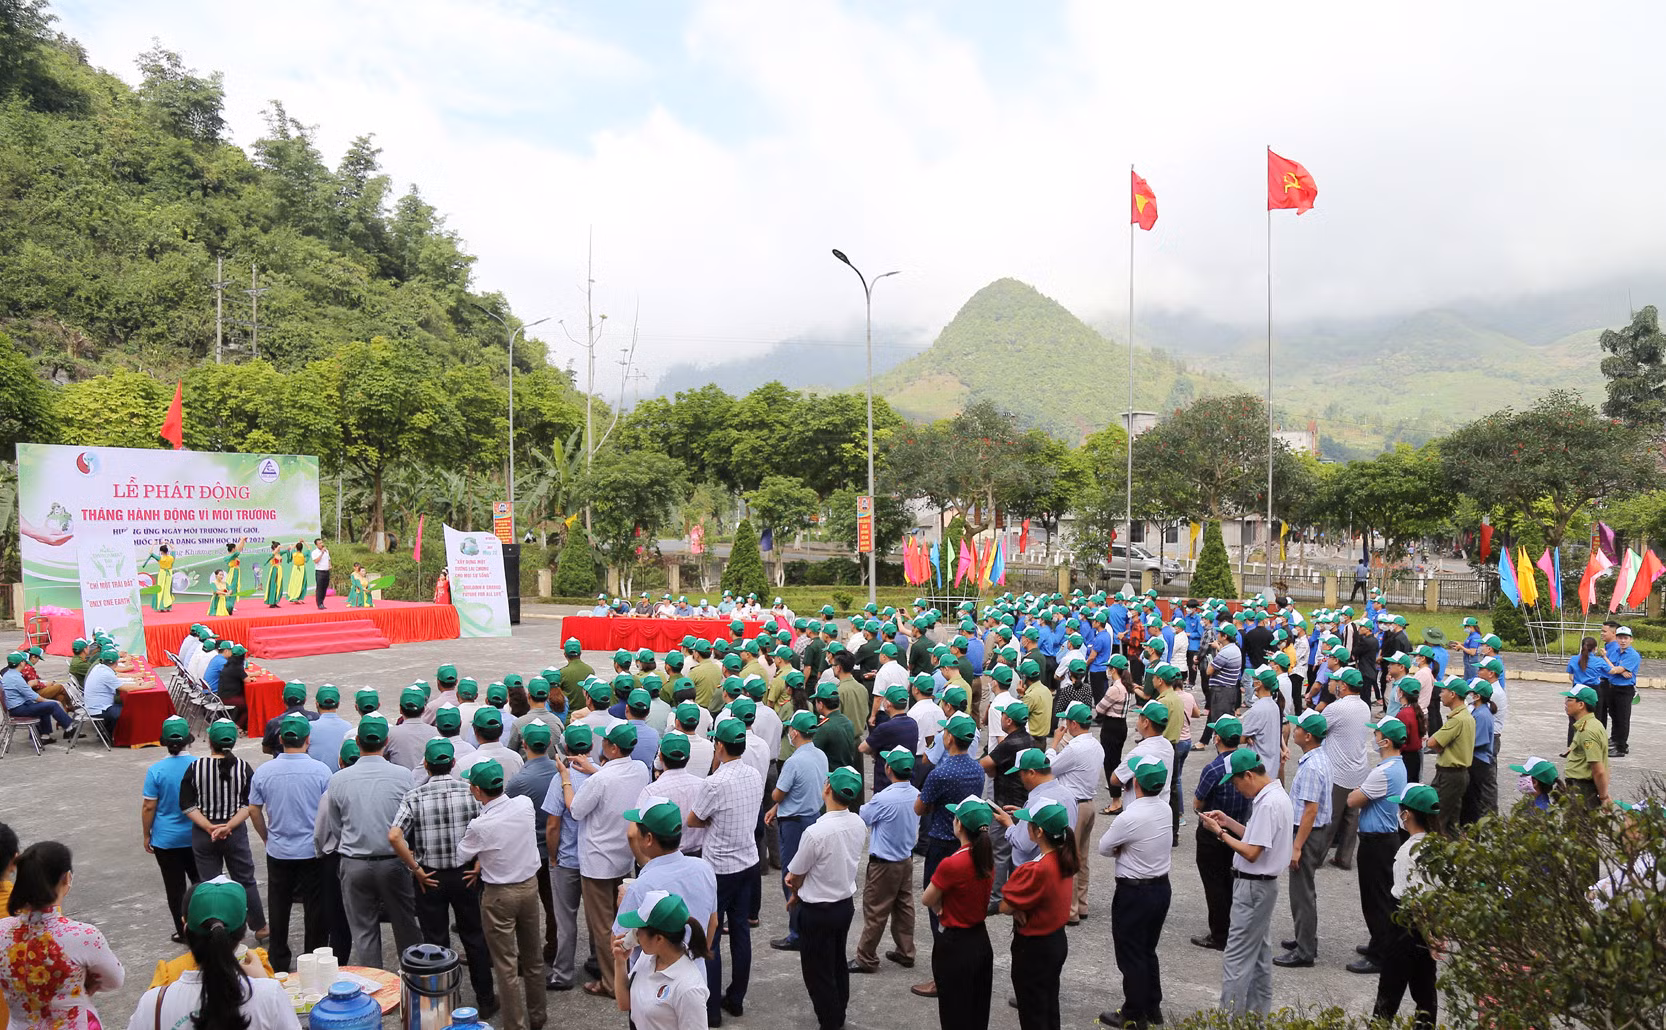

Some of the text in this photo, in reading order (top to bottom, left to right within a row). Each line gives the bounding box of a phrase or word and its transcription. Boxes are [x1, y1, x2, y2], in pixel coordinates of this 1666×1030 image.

[113, 476, 250, 502] LỄ PHÁT ĐỘNG
[81, 507, 277, 523] THÁNG HÀNH ĐỘNG VÌ MÔI TRƯỜNG
